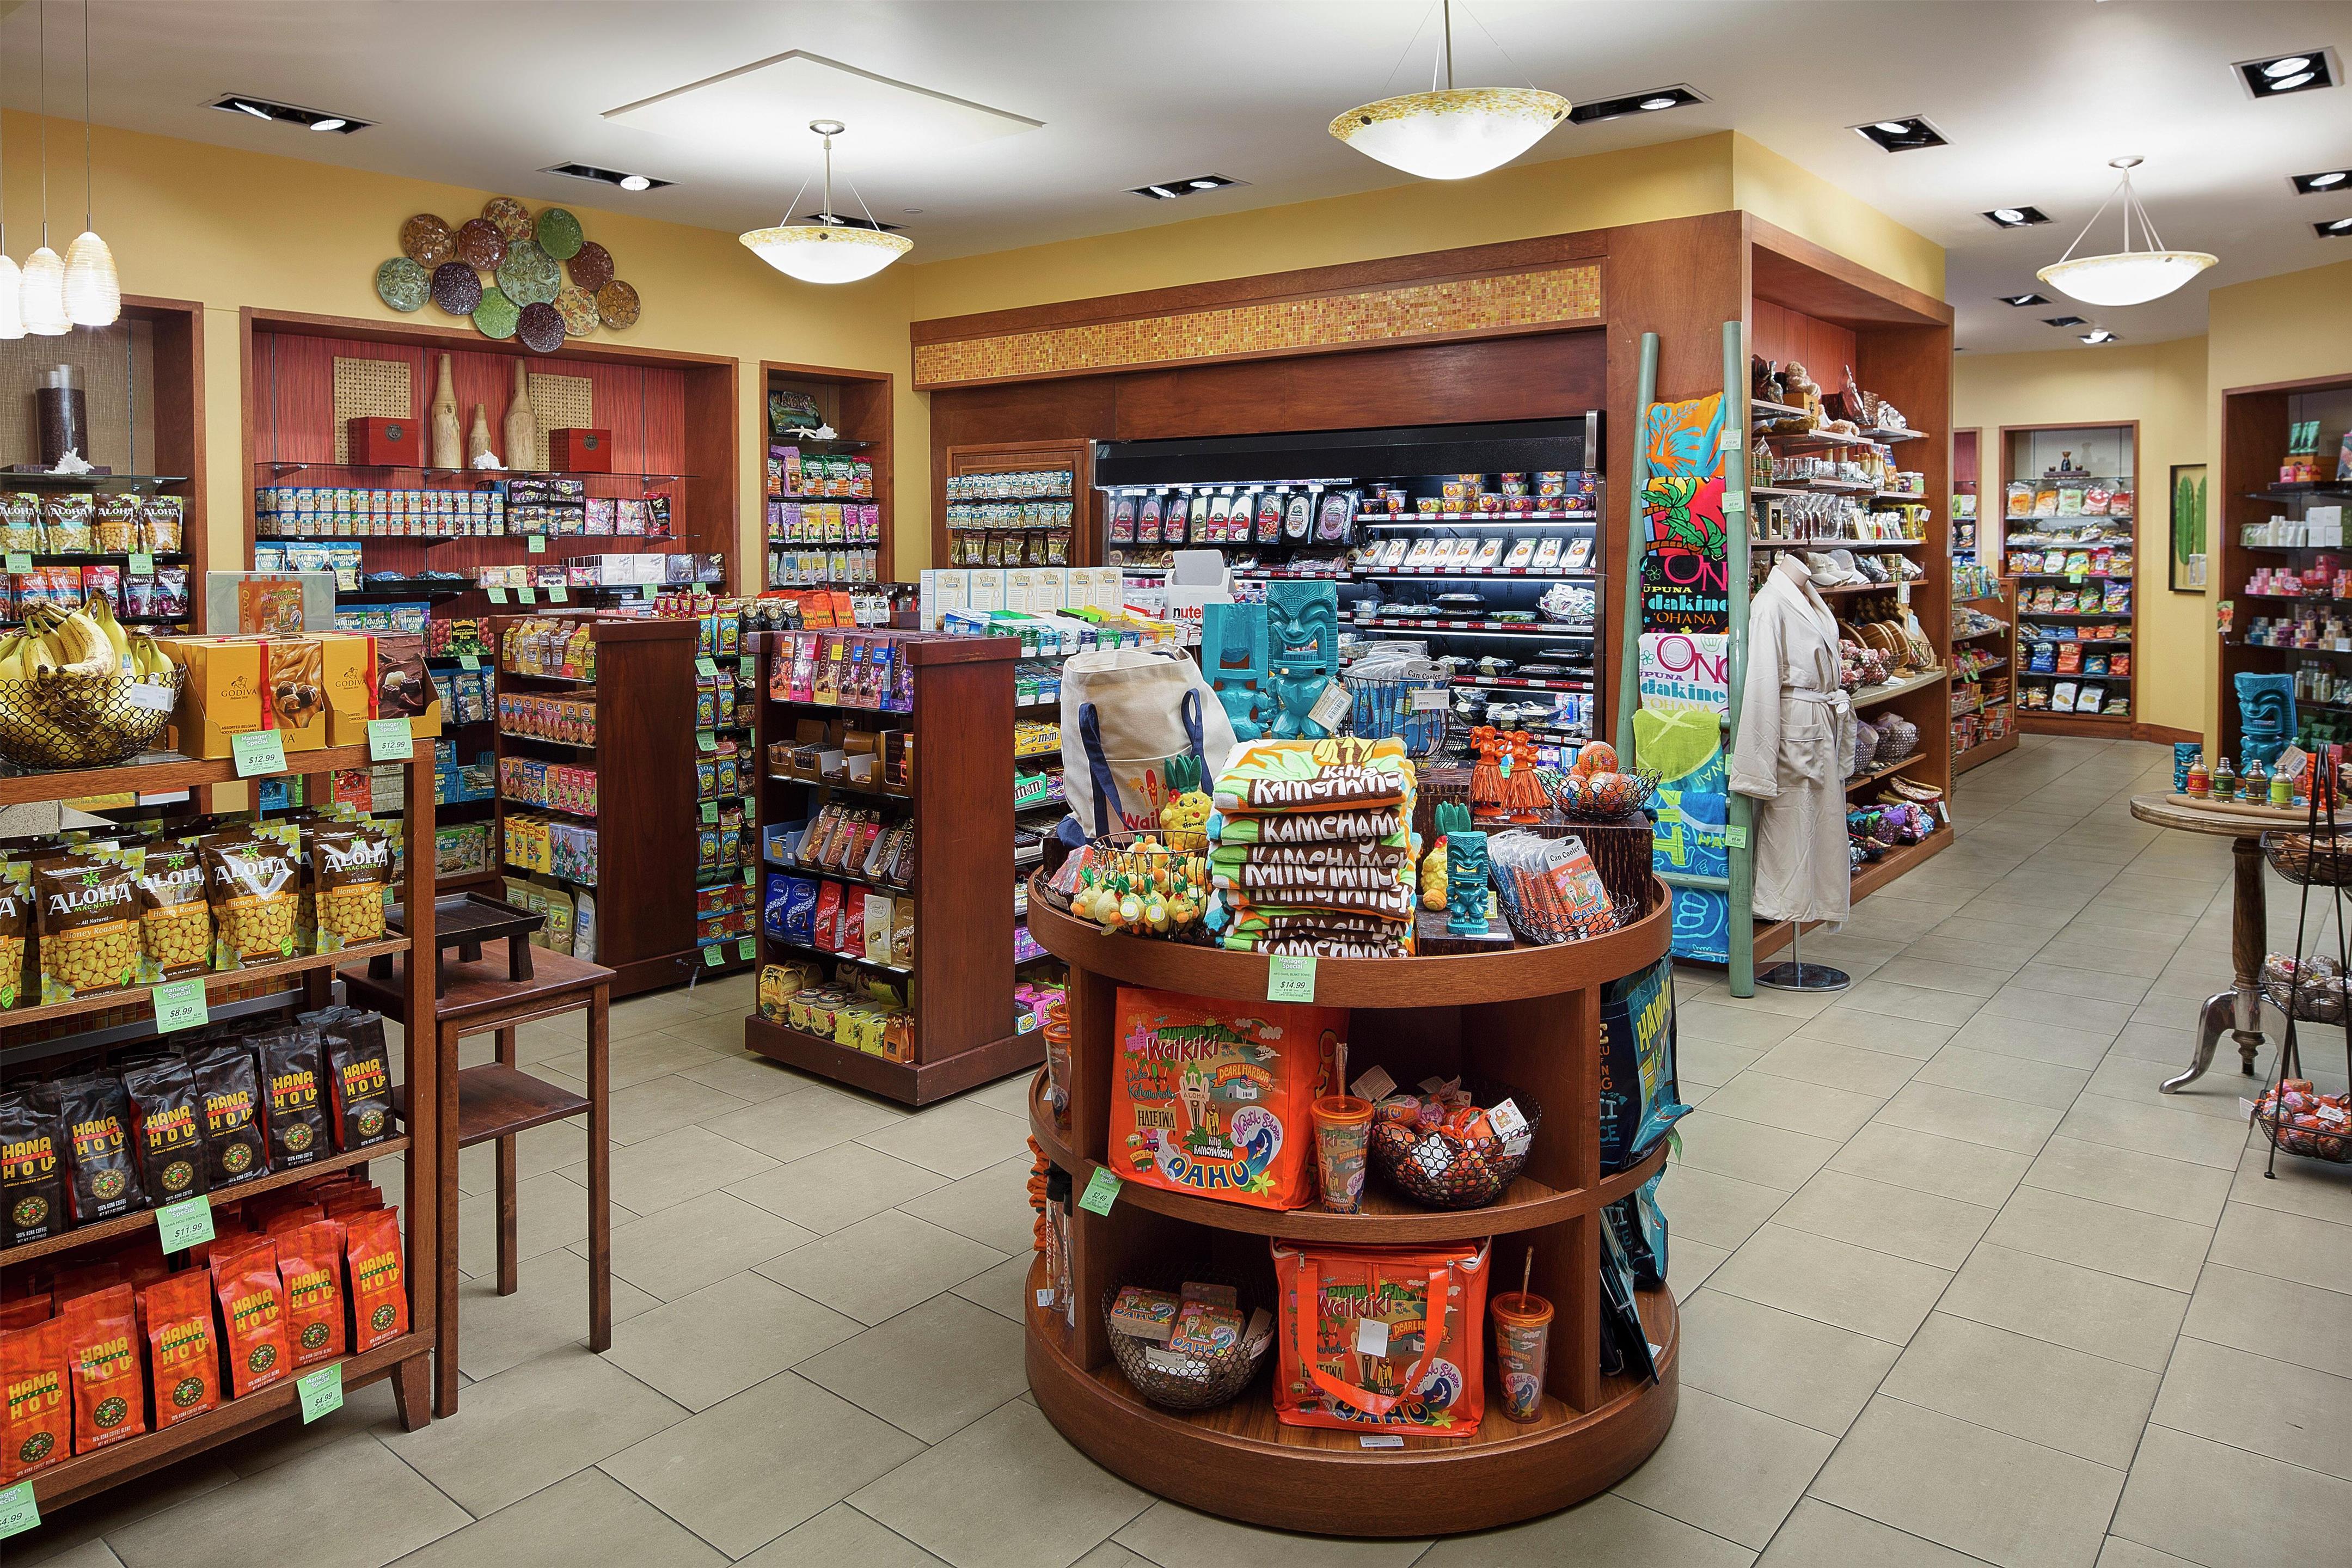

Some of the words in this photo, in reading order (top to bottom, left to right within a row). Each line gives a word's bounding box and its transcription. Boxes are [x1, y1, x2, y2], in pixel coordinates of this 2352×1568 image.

[50, 508, 88, 518] ALOHA
[98, 508, 133, 518] ALOHA
[144, 509, 179, 518] ALOHA
[401, 616, 425, 624] MAUNA
[721, 619, 738, 627] LION
[818, 638, 830, 678] GODIVA
[841, 639, 851, 680] GODIVA
[860, 641, 872, 682] GODIVA
[335, 679, 366, 688] GODIVA
[1641, 679, 1726, 703] dakine
[221, 689, 257, 697] GODIVA
[248, 754, 275, 763] $12.99
[722, 832, 740, 841] LION
[323, 850, 389, 874] ALOHA
[1550, 852, 1562, 862] Can
[1563, 844, 1580, 858] Cooler
[215, 858, 289, 886] ALOHA
[48, 883, 132, 915] ALOHA
[337, 886, 359, 895] Honey
[74, 904, 92, 912] MAC
[94, 900, 114, 909] NUTS
[231, 898, 254, 907] Honey
[255, 894, 282, 903] Roasted
[89, 916, 109, 924] Natural
[153, 909, 178, 919] Honey
[180, 903, 204, 913] Roasted
[66, 930, 92, 939] Honey
[94, 923, 123, 934] Roasted
[1278, 957, 1308, 965] Manager's
[163, 983, 195, 994] Manager's
[1280, 981, 1306, 989] $14.99
[168, 990, 191, 999] Special
[170, 1007, 193, 1018] $8.99
[1157, 1026, 1205, 1039] DIAMOND
[1207, 1024, 1235, 1042] HEAD
[1146, 1034, 1220, 1062] Waikiki
[343, 1058, 380, 1077] HANA
[1125, 1067, 1148, 1083] Duke
[1241, 1065, 1271, 1083] HARBOR
[273, 1071, 314, 1091] HANA
[346, 1075, 385, 1096] HOU
[207, 1091, 248, 1112] HANA
[274, 1088, 317, 1108] HOU
[146, 1106, 190, 1128] HANA
[209, 1108, 253, 1130] HOU
[72, 1116, 118, 1138] HANA
[75, 1128, 118, 1142] COFFEE
[150, 1124, 196, 1147] HOU
[1235, 1111, 1261, 1144] North
[1262, 1112, 1281, 1142] Shore
[2, 1137, 51, 1159] HANA
[76, 1132, 124, 1156] HOU
[4, 1151, 51, 1165] COFFEE
[3, 1156, 56, 1179] HOU
[1167, 1157, 1252, 1190] OAHU
[1092, 1191, 1107, 1202] $2.49
[166, 1200, 199, 1214] Manager's
[172, 1206, 197, 1218] Special
[16, 1217, 29, 1226] PURE
[32, 1211, 45, 1224] KONA
[35, 1227, 47, 1235] COFFEE
[175, 1223, 202, 1238] $11.99
[359, 1251, 395, 1273] HANA
[291, 1269, 330, 1289] HANA
[362, 1269, 400, 1292] HOU
[232, 1289, 273, 1313] HANA
[292, 1287, 335, 1308] HOU
[1318, 1293, 1392, 1319] Waikiki
[236, 1306, 279, 1333] HOU
[1113, 1308, 1157, 1321] OAHU
[161, 1320, 204, 1346] HANA
[163, 1333, 204, 1351] COFFEE
[80, 1337, 128, 1363] HANA
[163, 1338, 209, 1364] HOU
[83, 1351, 128, 1369] COFFEE
[83, 1356, 133, 1382] HOU
[9, 1370, 58, 1399] HANA
[306, 1369, 334, 1384] Manager's
[311, 1375, 330, 1388] Special
[1439, 1363, 1460, 1389] Shore
[11, 1385, 58, 1404] COFFEE
[315, 1392, 333, 1406] $4.99
[10, 1389, 63, 1420] HOU
